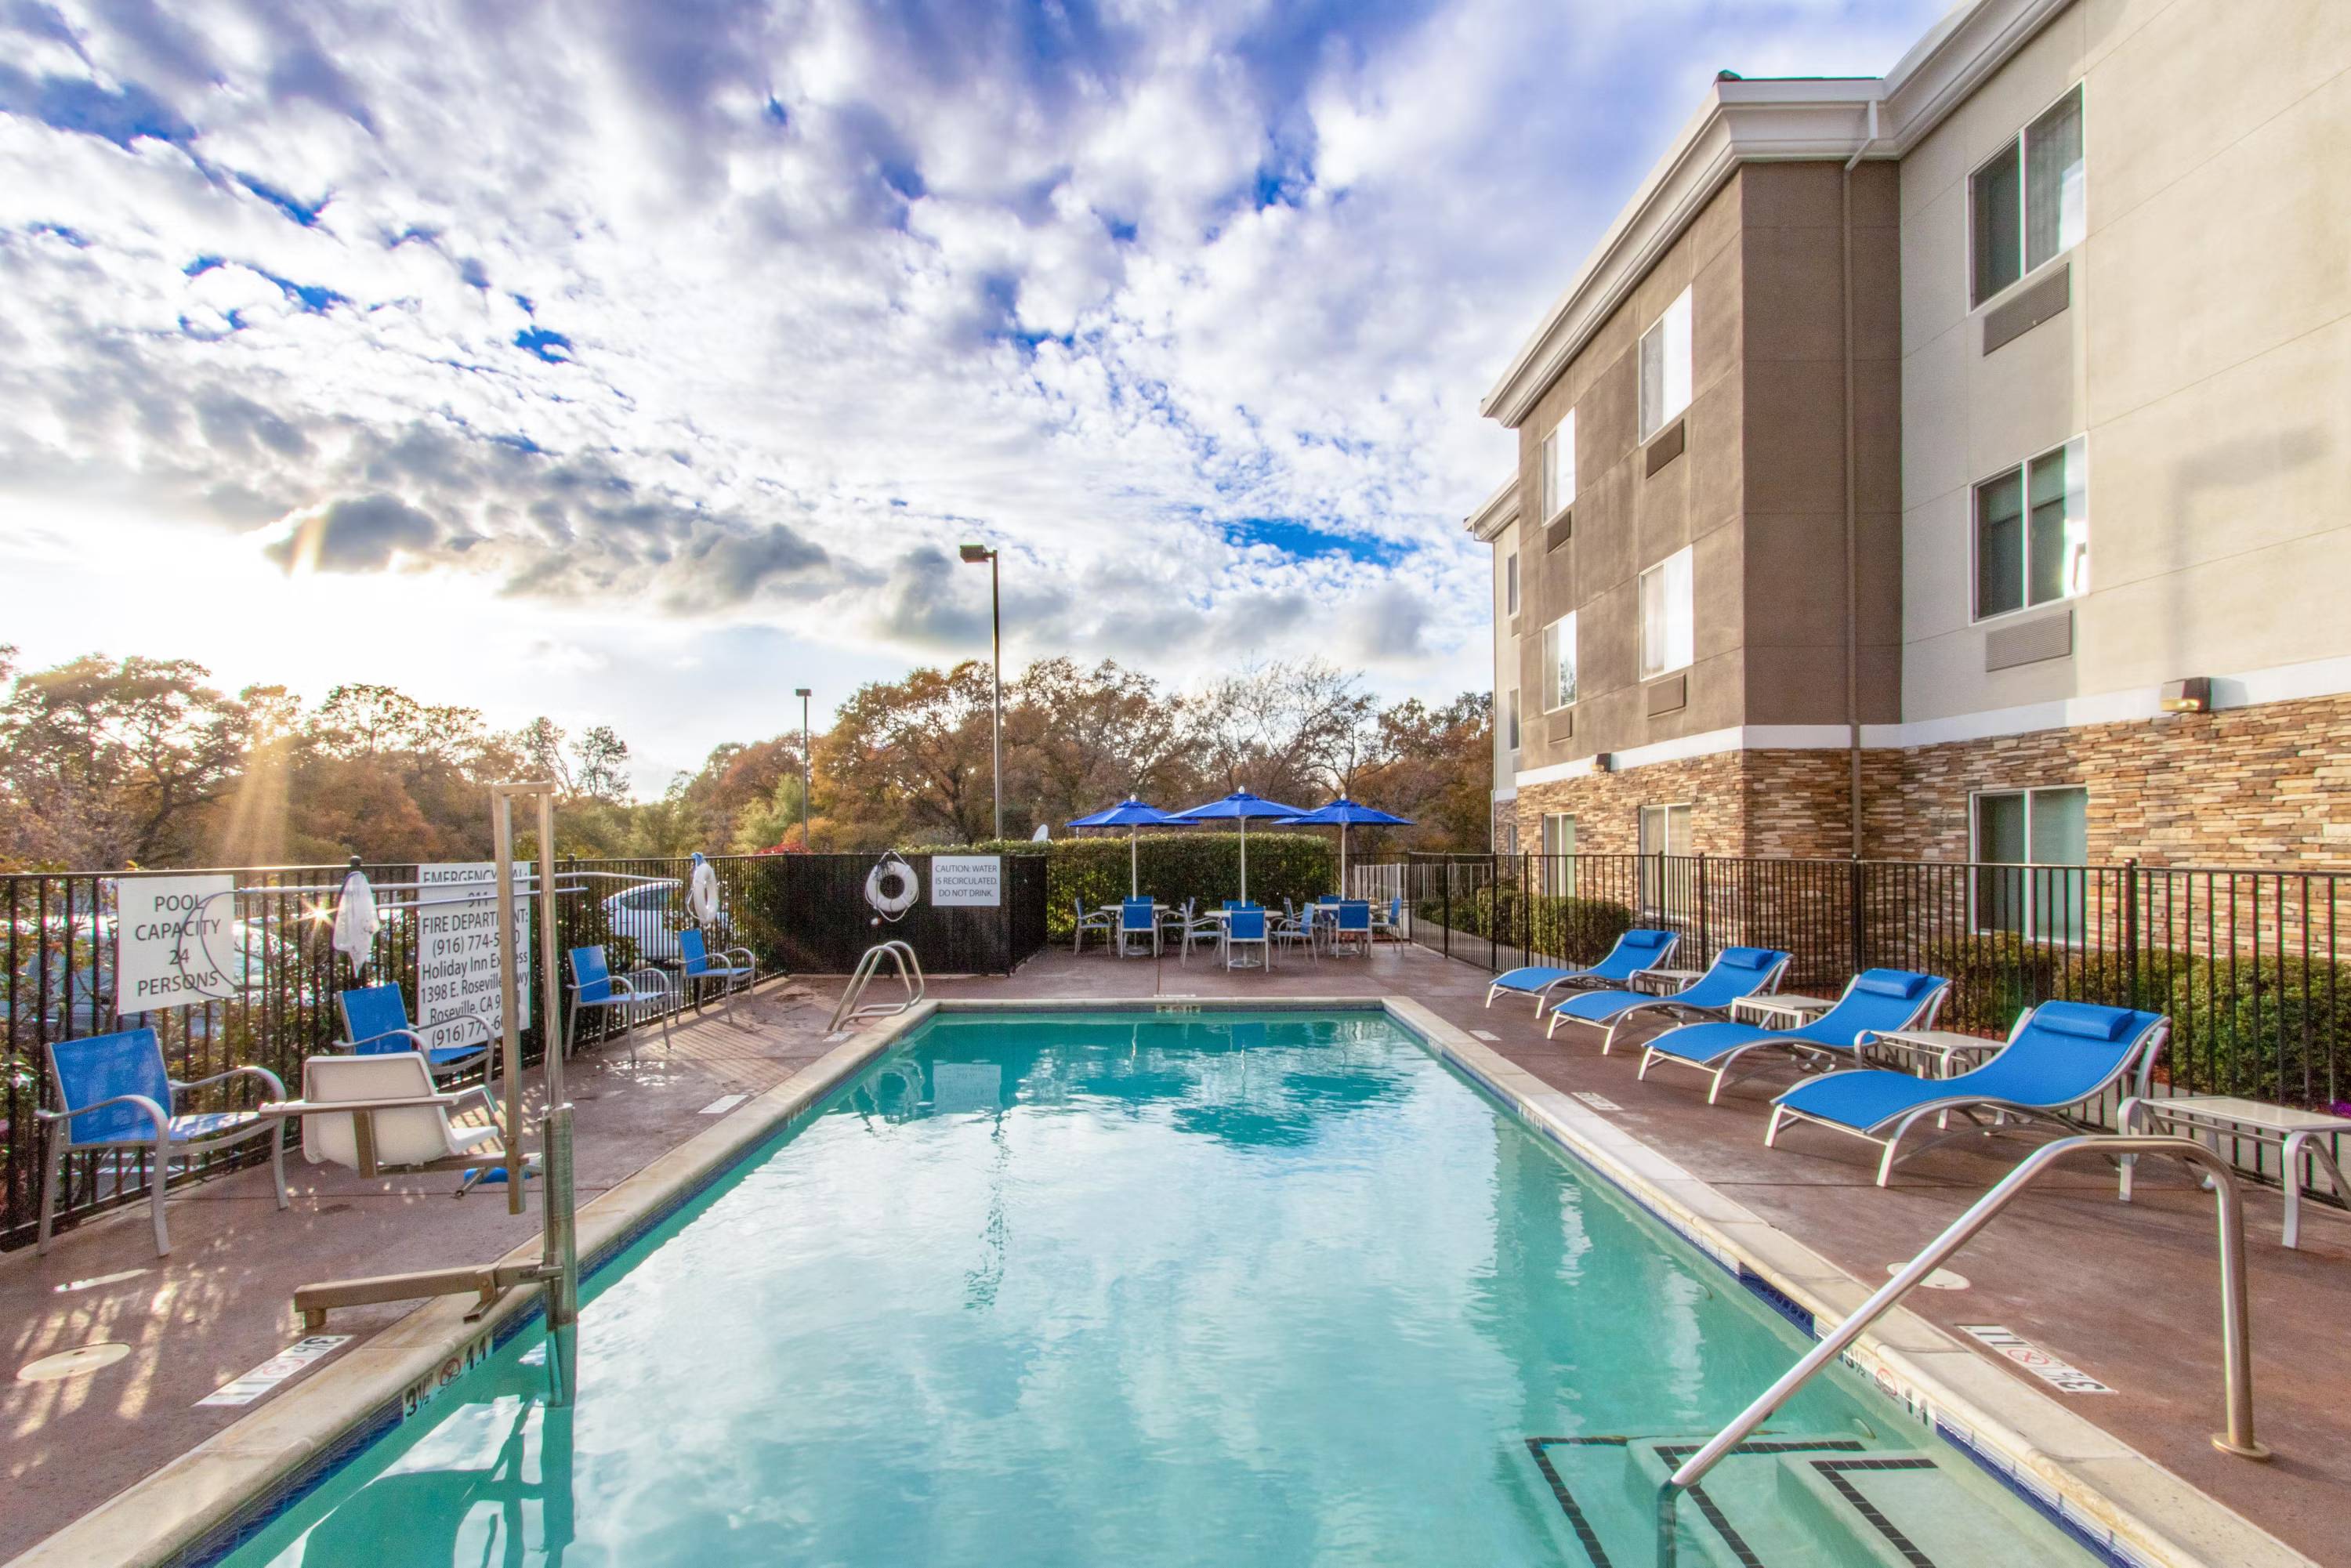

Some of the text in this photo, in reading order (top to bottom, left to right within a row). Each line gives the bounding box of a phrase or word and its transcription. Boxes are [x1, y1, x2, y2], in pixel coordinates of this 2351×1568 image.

[972, 864, 998, 873] WATER
[154, 894, 204, 912] POOL
[135, 918, 221, 941] CAPACITY
[422, 908, 529, 935] FIRE DEPARTNT:
[433, 929, 520, 958] (916) 774-50
[168, 948, 190, 965] 24
[422, 958, 468, 981] Holiday
[470, 957, 488, 972] Inn
[137, 970, 219, 998] PERSONS
[421, 983, 448, 1004] 1398
[450, 981, 459, 998] E.
[480, 995, 494, 1012] CA
[433, 1023, 465, 1049] (916)
